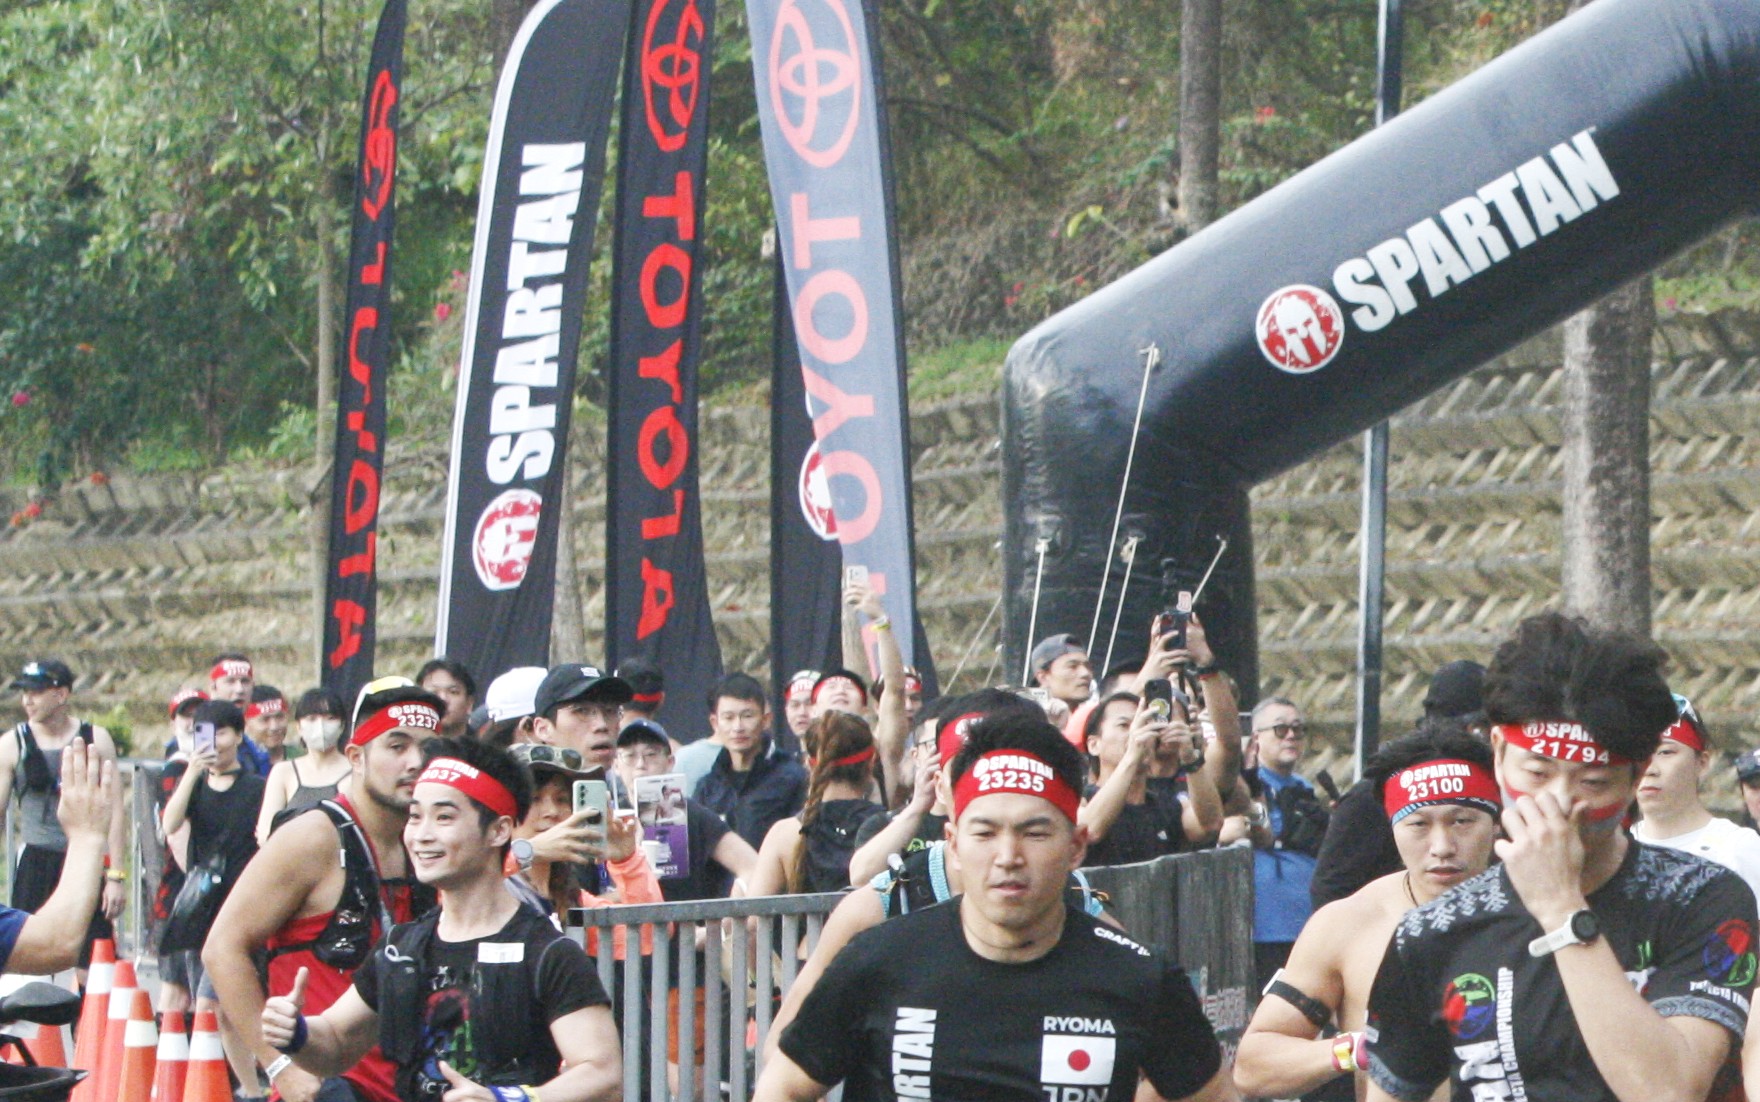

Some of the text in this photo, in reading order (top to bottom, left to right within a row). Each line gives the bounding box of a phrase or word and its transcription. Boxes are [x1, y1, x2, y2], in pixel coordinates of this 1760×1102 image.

[1333, 128, 1620, 332] SPARTAN
[486, 142, 586, 484] SPARTAN
[397, 715, 437, 731] 23237
[1529, 738, 1610, 764] 21794
[990, 755, 1053, 780] SPARTAN
[1414, 763, 1470, 781] SPARTAN
[979, 770, 1045, 792] 23235
[1408, 777, 1464, 801] 23100
[1043, 1016, 1116, 1034] RYOMA
[1496, 966, 1519, 1072] CHAMPIONSHIP
